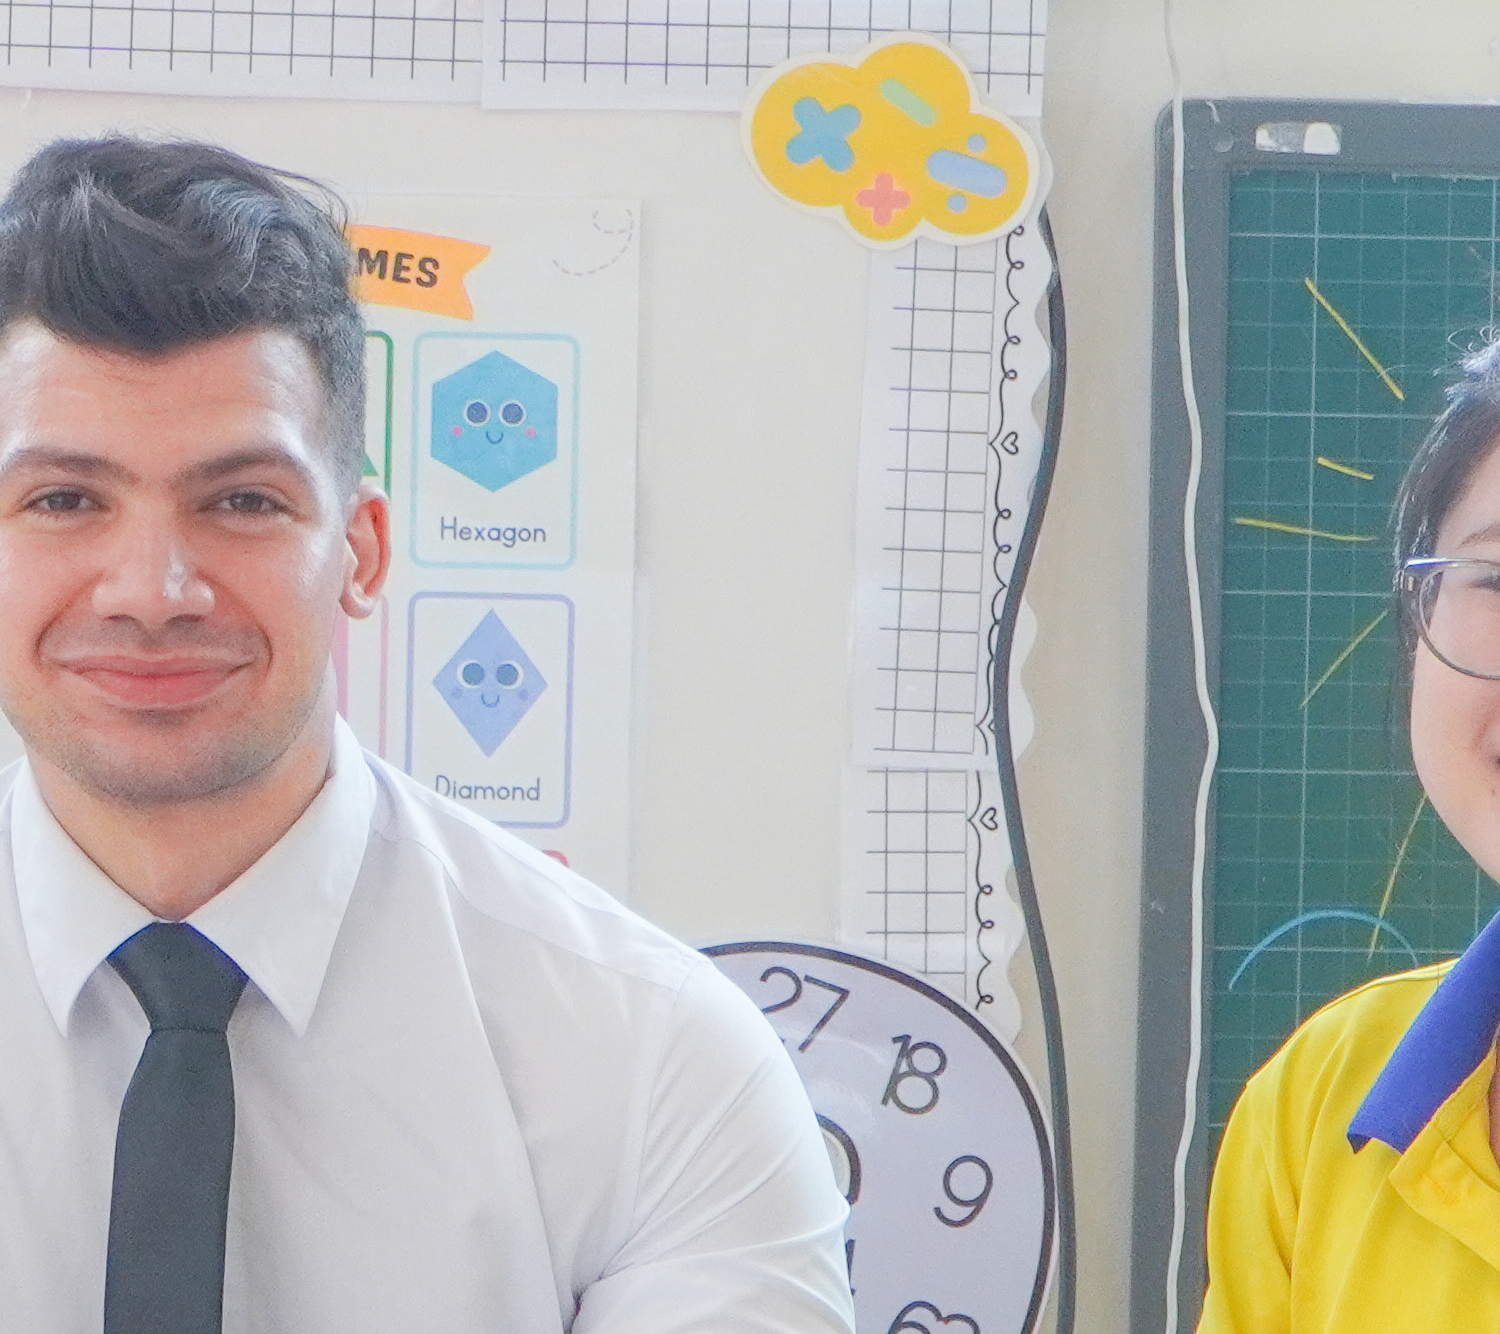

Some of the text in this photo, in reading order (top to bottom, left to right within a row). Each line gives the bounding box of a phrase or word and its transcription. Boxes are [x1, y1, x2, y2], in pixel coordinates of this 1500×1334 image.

[355, 247, 441, 289] MES
[440, 516, 547, 549] Hexagon
[435, 775, 541, 803] Diamond
[933, 1155, 994, 1228] 9
